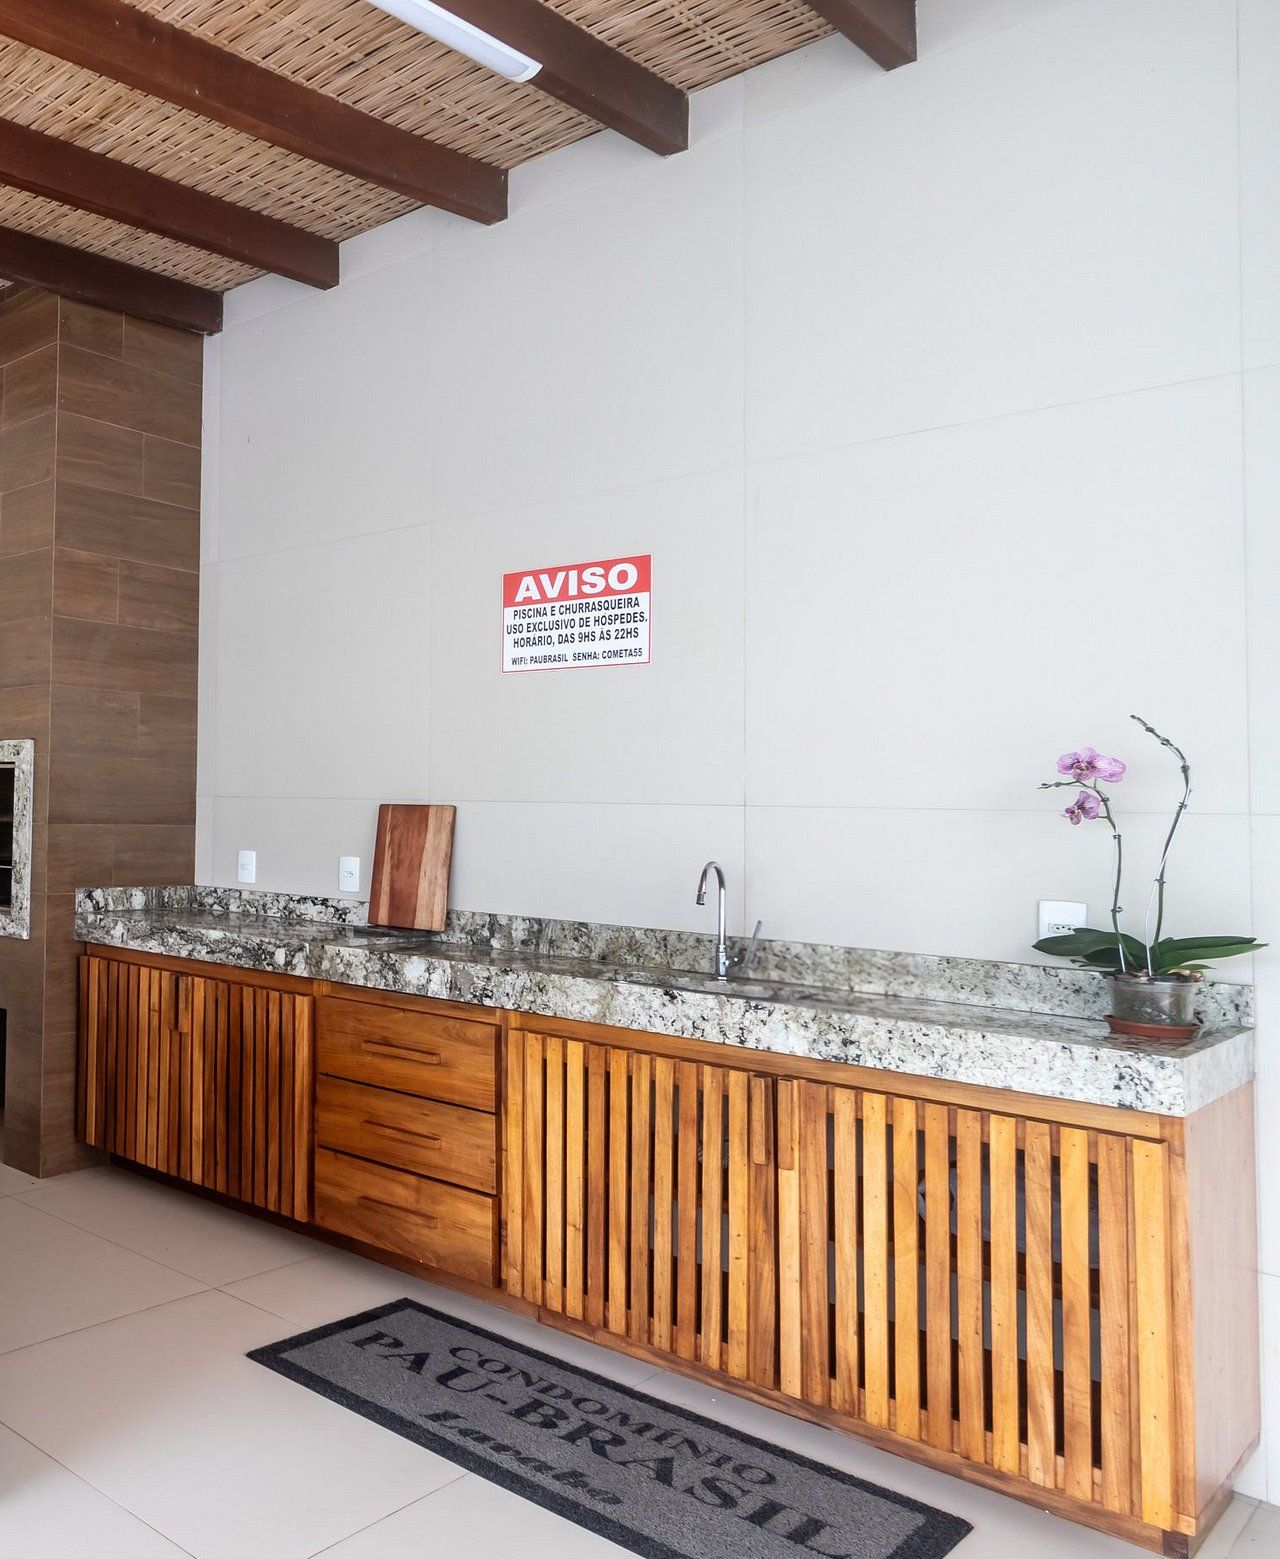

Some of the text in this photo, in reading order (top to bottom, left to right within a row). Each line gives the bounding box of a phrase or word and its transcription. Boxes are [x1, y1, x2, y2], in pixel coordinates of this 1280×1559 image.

[514, 562, 638, 602] AVISO
[513, 596, 640, 620] PISCINA E CHURRASQUEIRA
[506, 623, 524, 635] USO
[526, 618, 576, 633] EXCLUSIVO
[579, 616, 590, 628] DE
[513, 634, 555, 649] HORÁRIO,
[558, 632, 576, 645] DAS
[578, 630, 596, 643] 9HS
[614, 627, 639, 640] 22HS
[511, 647, 643, 666] WIFI: PAUBRASIL SENHA: COMETA55
[449, 1345, 777, 1486] CONDOMÍNIO
[349, 1330, 855, 1559] PAU-BRASIL
